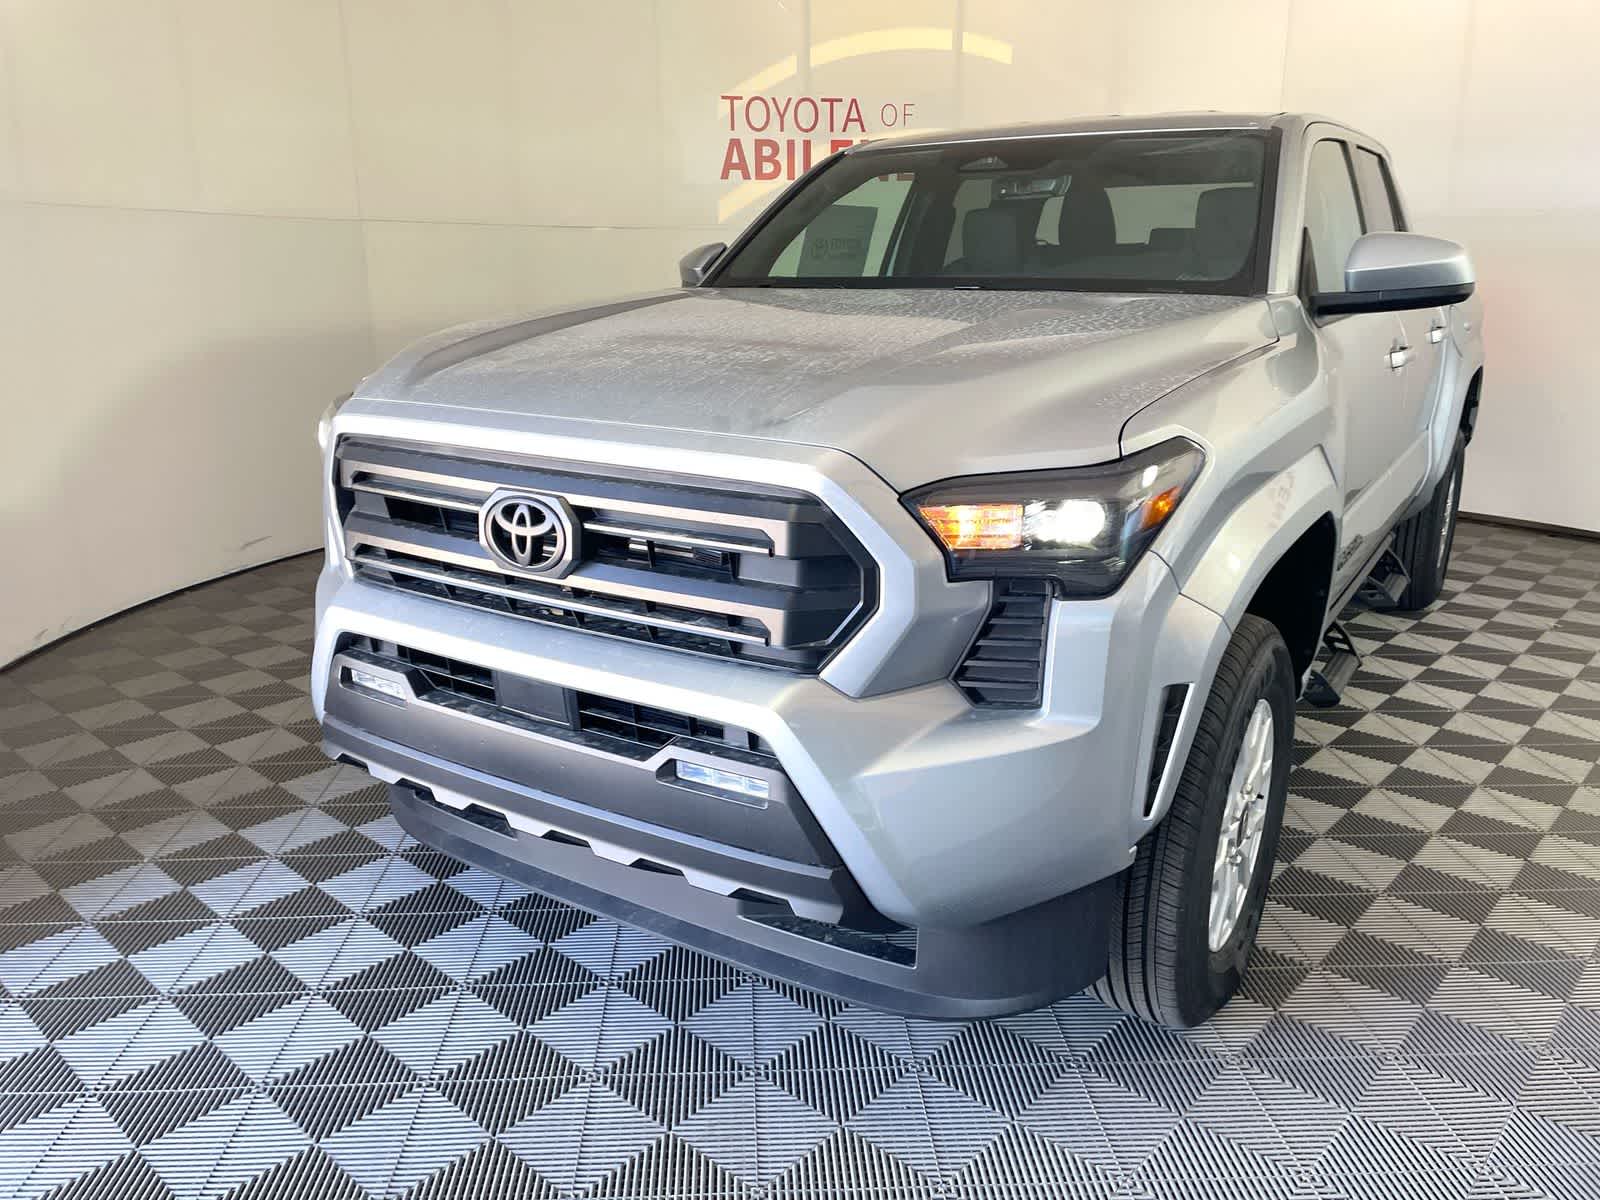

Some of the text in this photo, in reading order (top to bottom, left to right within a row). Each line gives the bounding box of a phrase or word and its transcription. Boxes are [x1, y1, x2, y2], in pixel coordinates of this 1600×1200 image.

[720, 95, 915, 133] TOYOTA OF
[720, 138, 914, 181] ABIL
